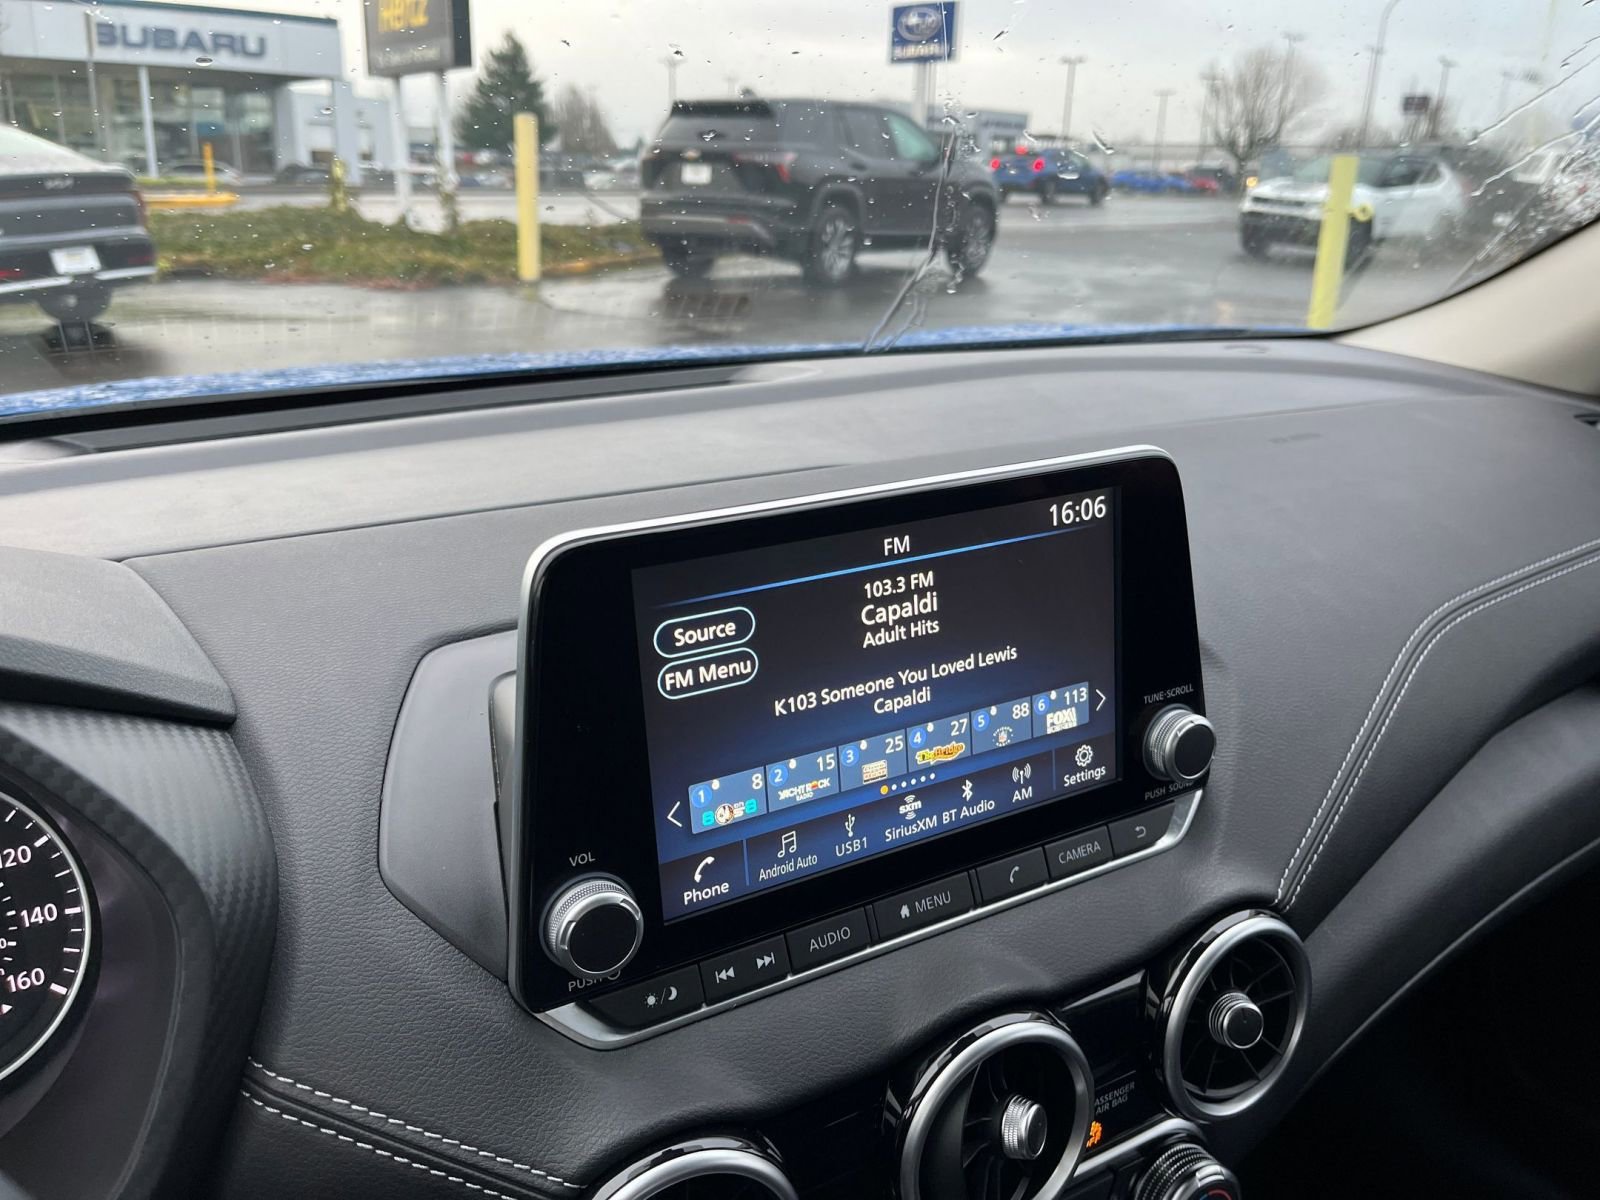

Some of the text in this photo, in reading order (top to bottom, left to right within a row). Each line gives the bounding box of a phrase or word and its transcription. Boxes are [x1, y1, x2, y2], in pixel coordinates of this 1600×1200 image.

[1049, 495, 1106, 526] 16:06
[883, 535, 911, 556] FM
[864, 571, 934, 599] 103.3 FM
[861, 592, 938, 626] Capaldi
[673, 621, 736, 647] Source
[863, 619, 940, 648] Adult Hits
[664, 660, 752, 691] FM Menu
[774, 645, 1018, 716] K103 Someone You Loved Lewis
[873, 686, 931, 714] Capaldi
[1038, 699, 1046, 711] 6
[1064, 687, 1087, 706] 113
[978, 715, 985, 727] 5
[1012, 702, 1030, 719] 88
[913, 731, 922, 744] 4
[950, 718, 968, 736] 27
[885, 735, 904, 754] 25
[816, 753, 835, 772] 15
[846, 750, 854, 763] 3
[751, 773, 763, 790] 8
[774, 769, 783, 783] 2
[1064, 766, 1106, 787] Settings
[698, 790, 705, 803] 1
[1012, 786, 1033, 803] AM
[1144, 786, 1166, 800] PUSH
[942, 799, 995, 824] BT Audio
[885, 815, 938, 842] SiriusXM
[835, 837, 867, 857] USB1
[1058, 840, 1101, 865] CAMERA
[569, 851, 596, 867] VOL
[759, 855, 818, 882] Android Auto
[683, 882, 730, 905] Phone
[915, 891, 952, 914] MENU
[20, 903, 58, 927] 140
[809, 926, 851, 952] AUDIO
[7, 968, 45, 993] 160
[1094, 1081, 1136, 1105] ASSENGER
[1096, 1094, 1128, 1116] AIR BAG
